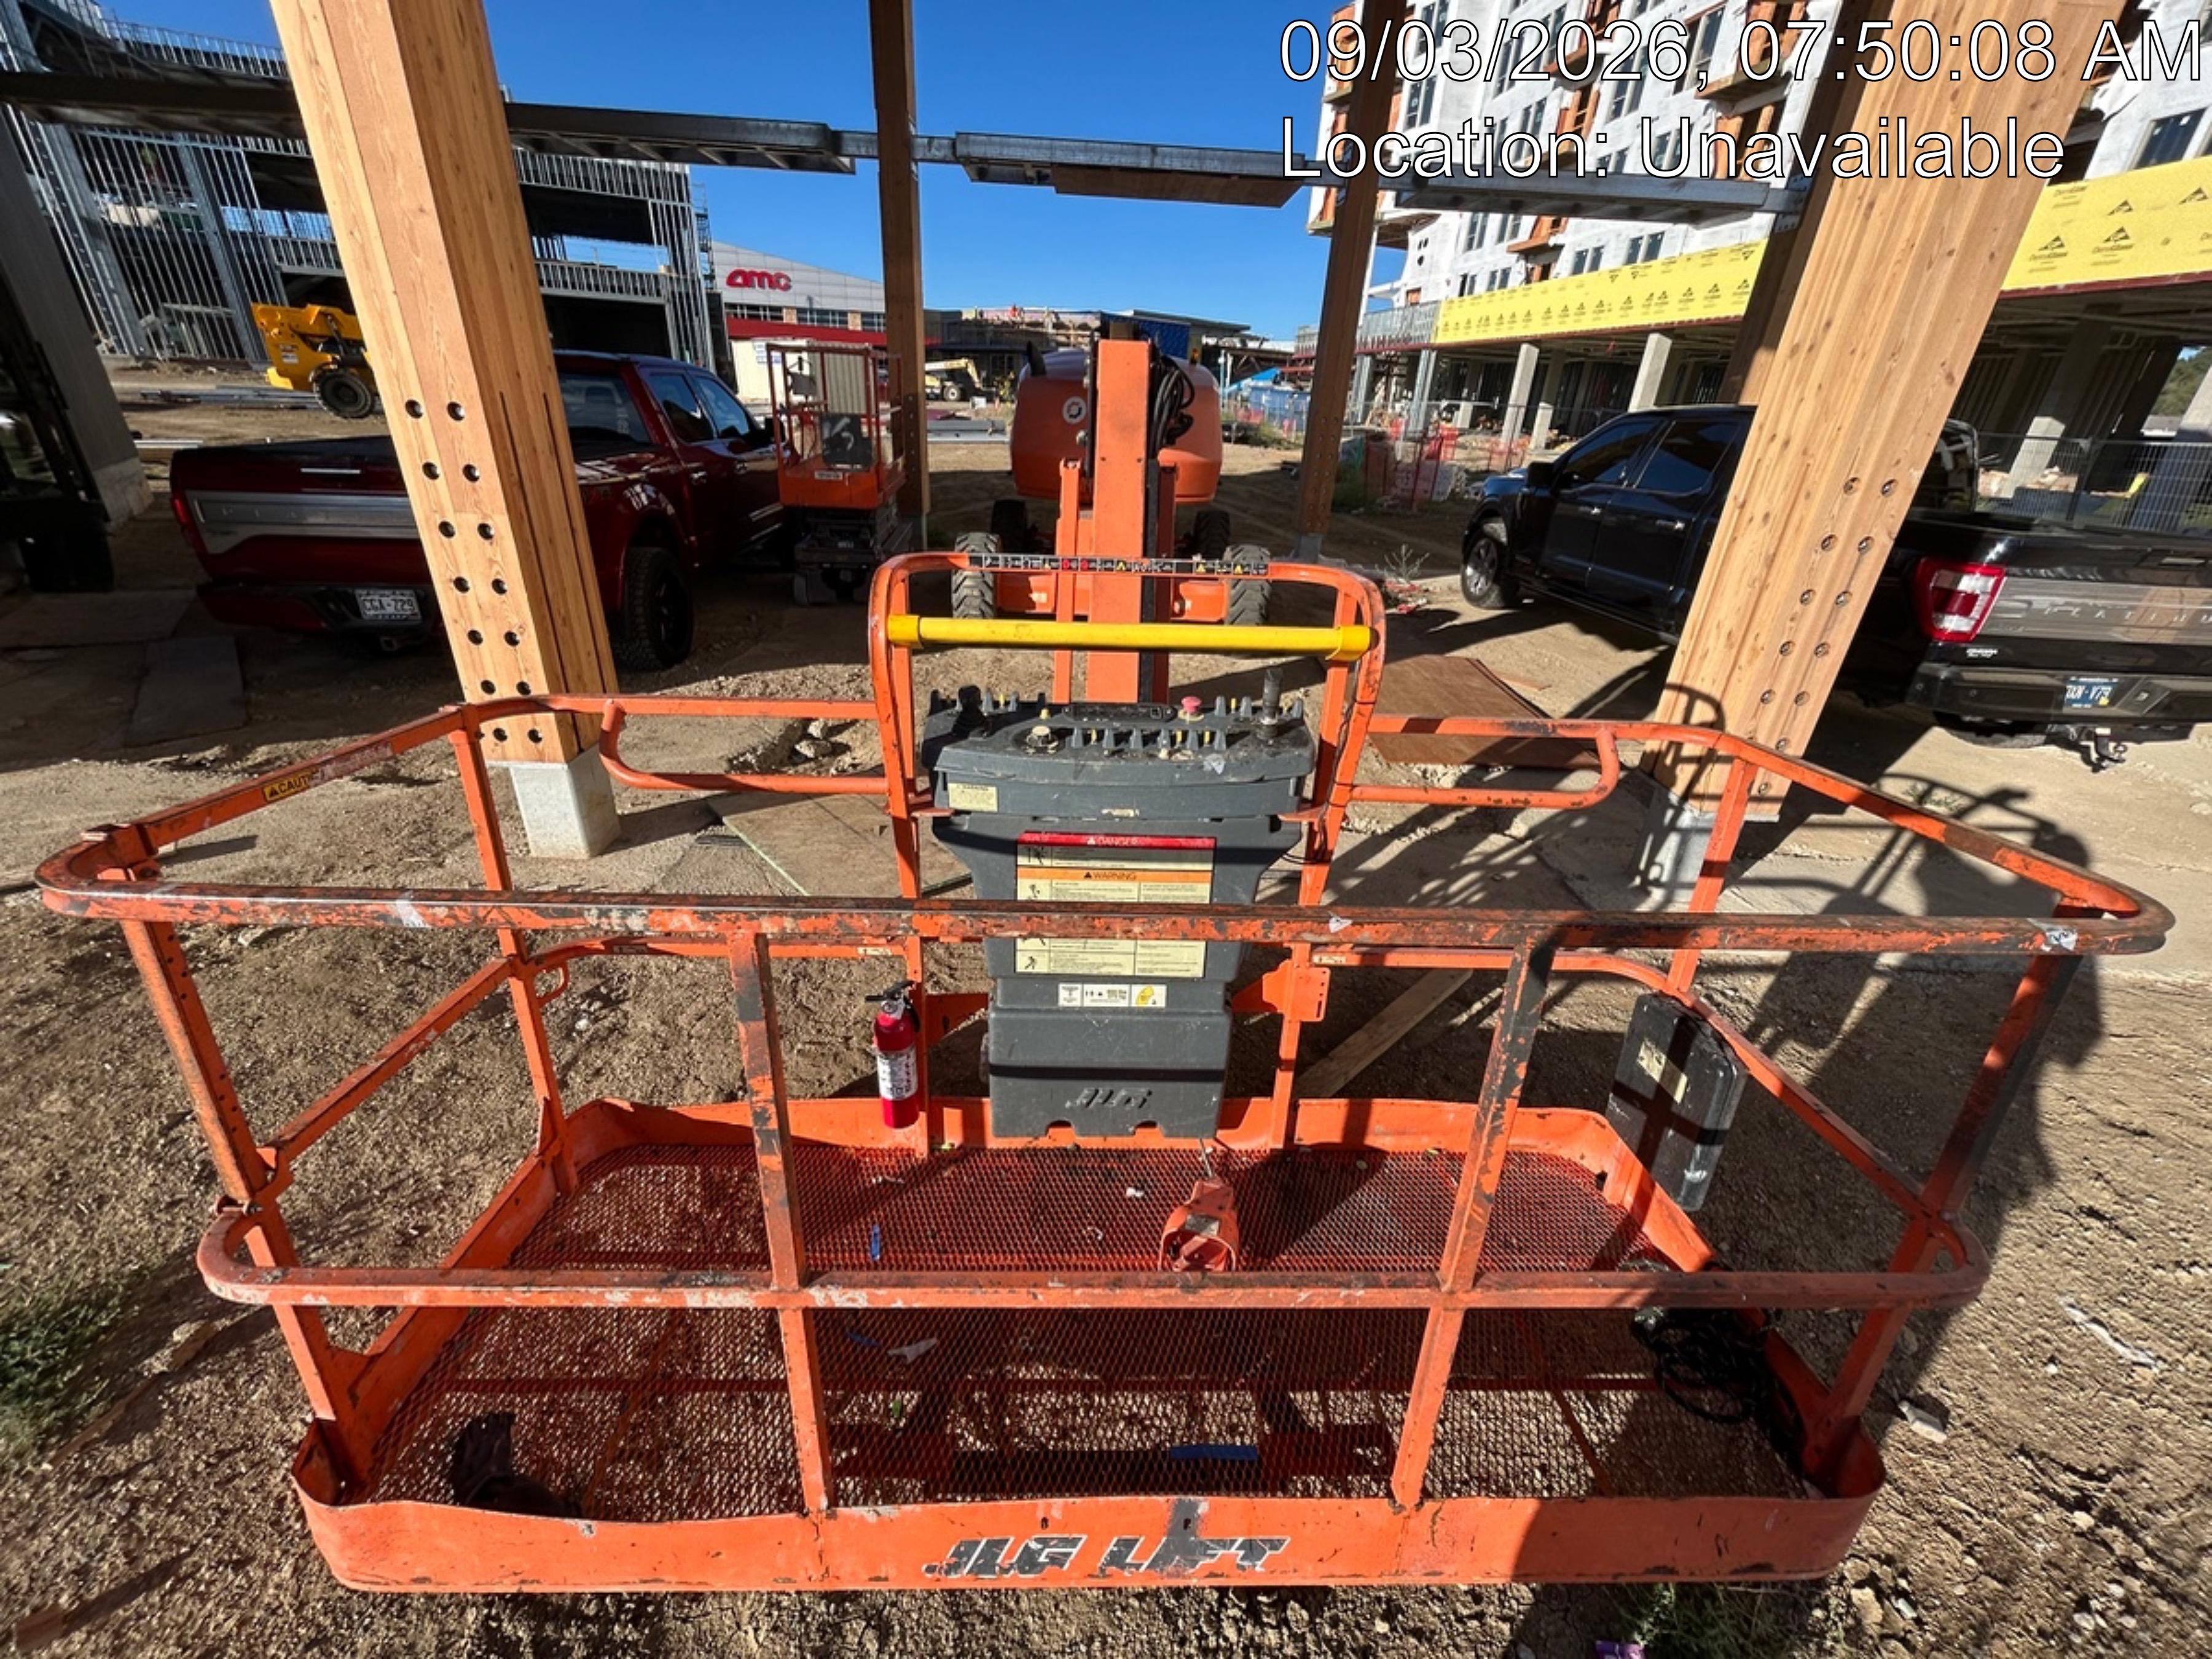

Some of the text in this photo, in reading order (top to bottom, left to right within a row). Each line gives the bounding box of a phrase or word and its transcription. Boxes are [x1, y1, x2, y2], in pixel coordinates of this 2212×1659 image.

[726, 269, 792, 291] amc
[1097, 836, 1139, 846] DANGER
[1093, 871, 1137, 881] WARNING
[922, 1534, 1088, 1578] JLG
